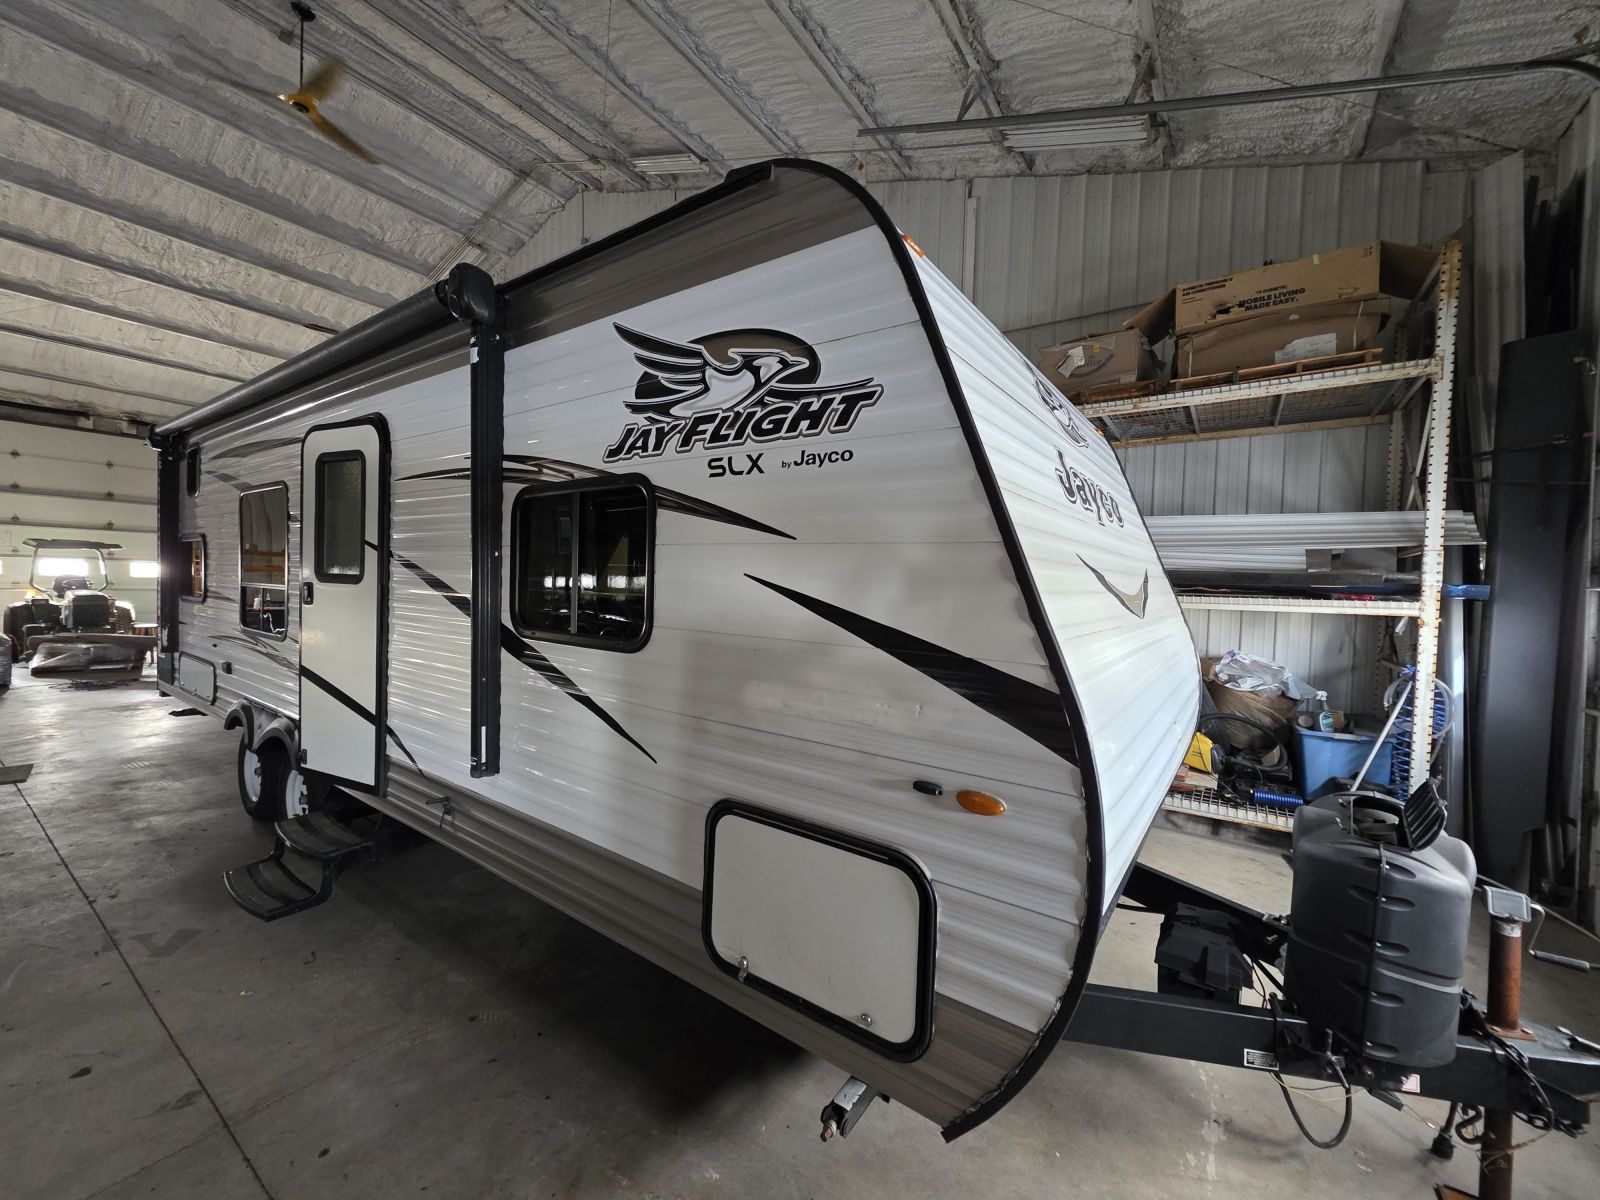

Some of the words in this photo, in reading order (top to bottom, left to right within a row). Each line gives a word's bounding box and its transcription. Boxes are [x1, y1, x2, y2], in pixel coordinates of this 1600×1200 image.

[1239, 293, 1273, 308] MOBILE
[1273, 287, 1306, 300] LIVING
[1244, 301, 1271, 312] MADE
[1272, 296, 1299, 306] EASY.
[707, 453, 765, 478] SLX
[781, 460, 792, 469] by
[793, 450, 854, 468] Jayco
[1055, 449, 1124, 528] Jayco
